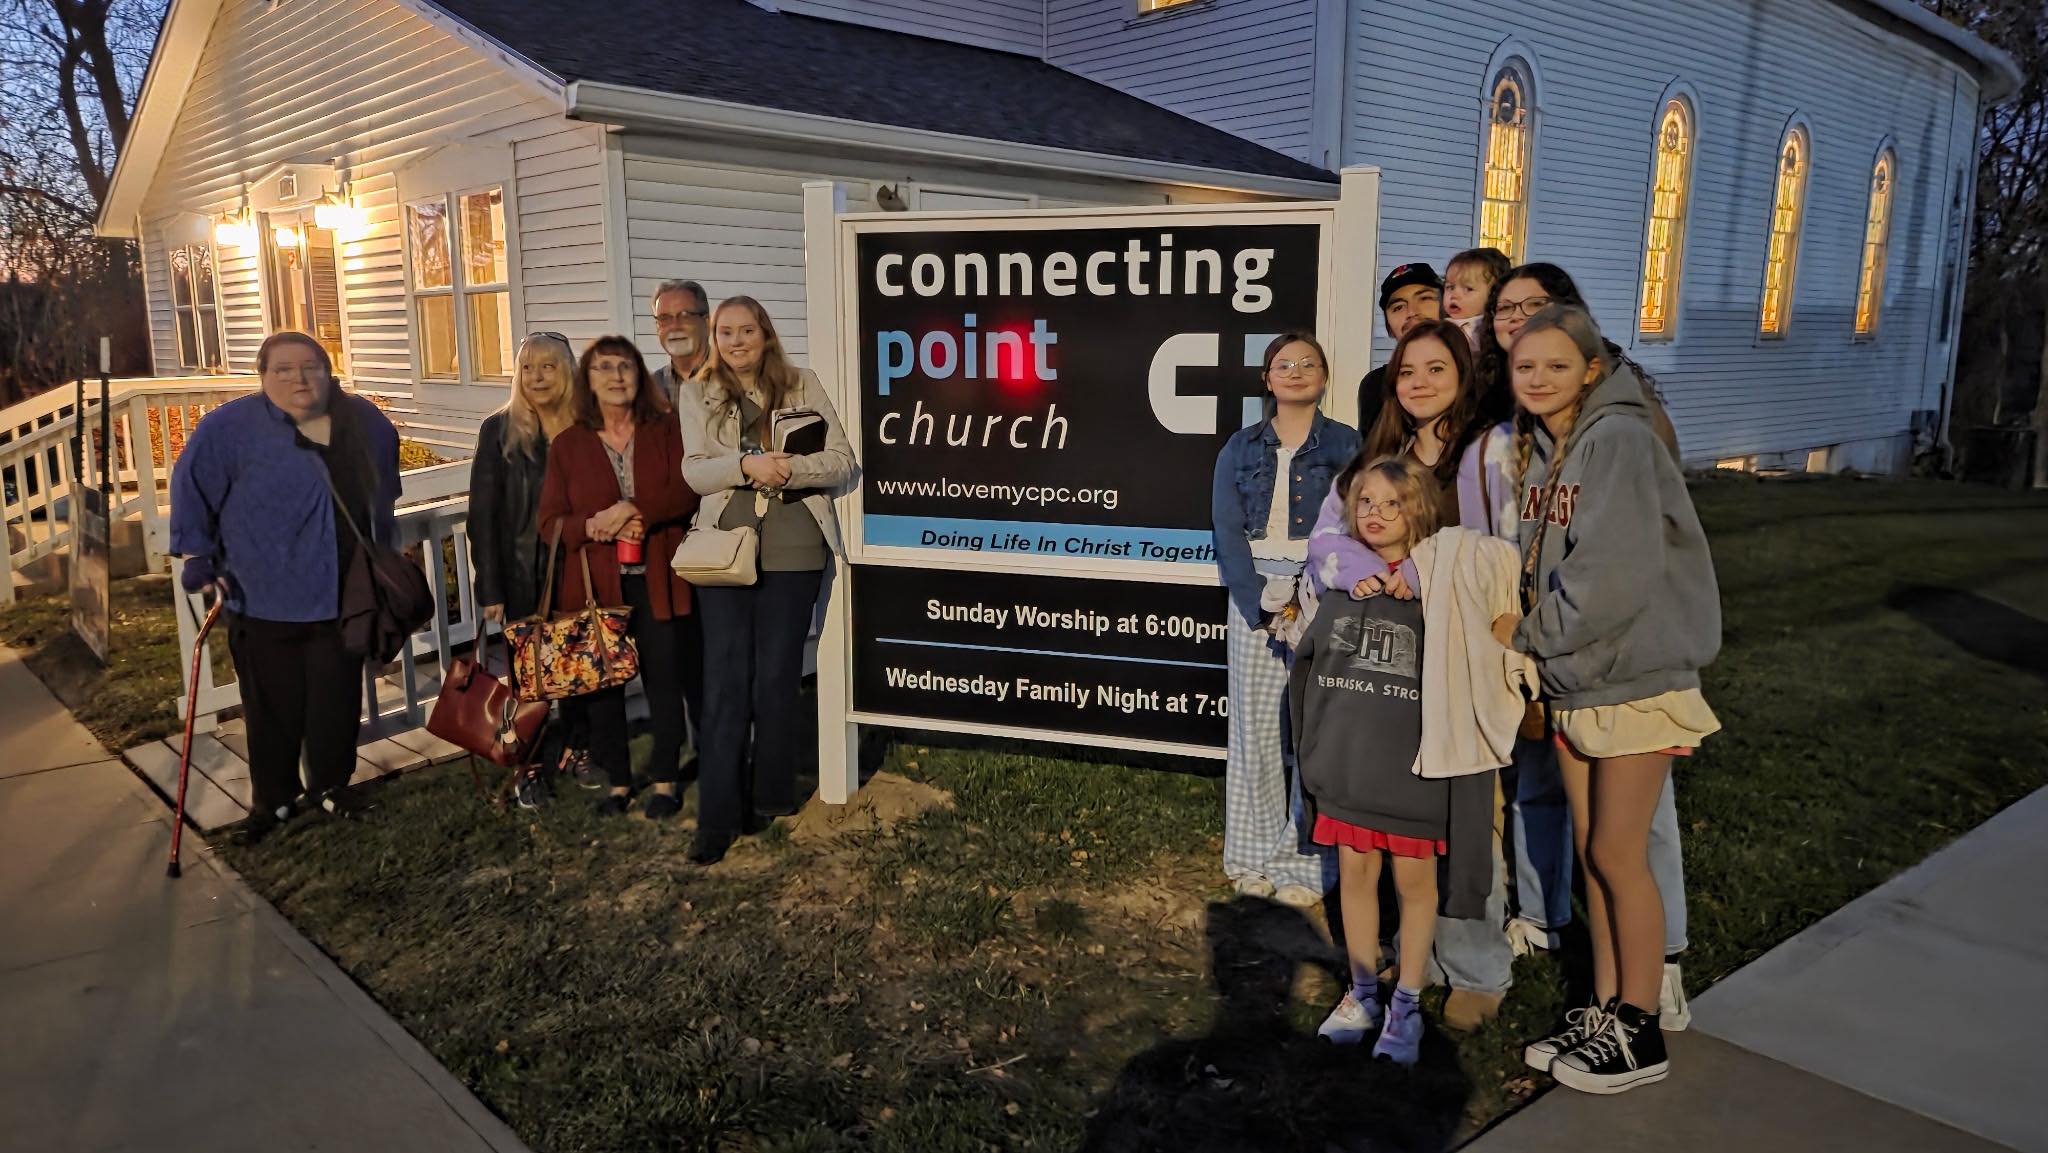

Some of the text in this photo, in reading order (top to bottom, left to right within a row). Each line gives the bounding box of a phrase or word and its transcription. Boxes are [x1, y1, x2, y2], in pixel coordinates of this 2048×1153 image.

[876, 234, 1275, 313] connecting
[877, 313, 1058, 396] point
[879, 401, 1068, 450] church
[877, 478, 1119, 510] www.lovemycpc.org
[921, 530, 1217, 562] Doing Life In Christ Togeth
[927, 599, 1009, 630] Sunday
[1015, 605, 1110, 636] Worship
[1116, 613, 1139, 634] at
[886, 667, 1228, 717] Wednesday Family Night at 7:0
[1383, 684, 1419, 700] STRO
